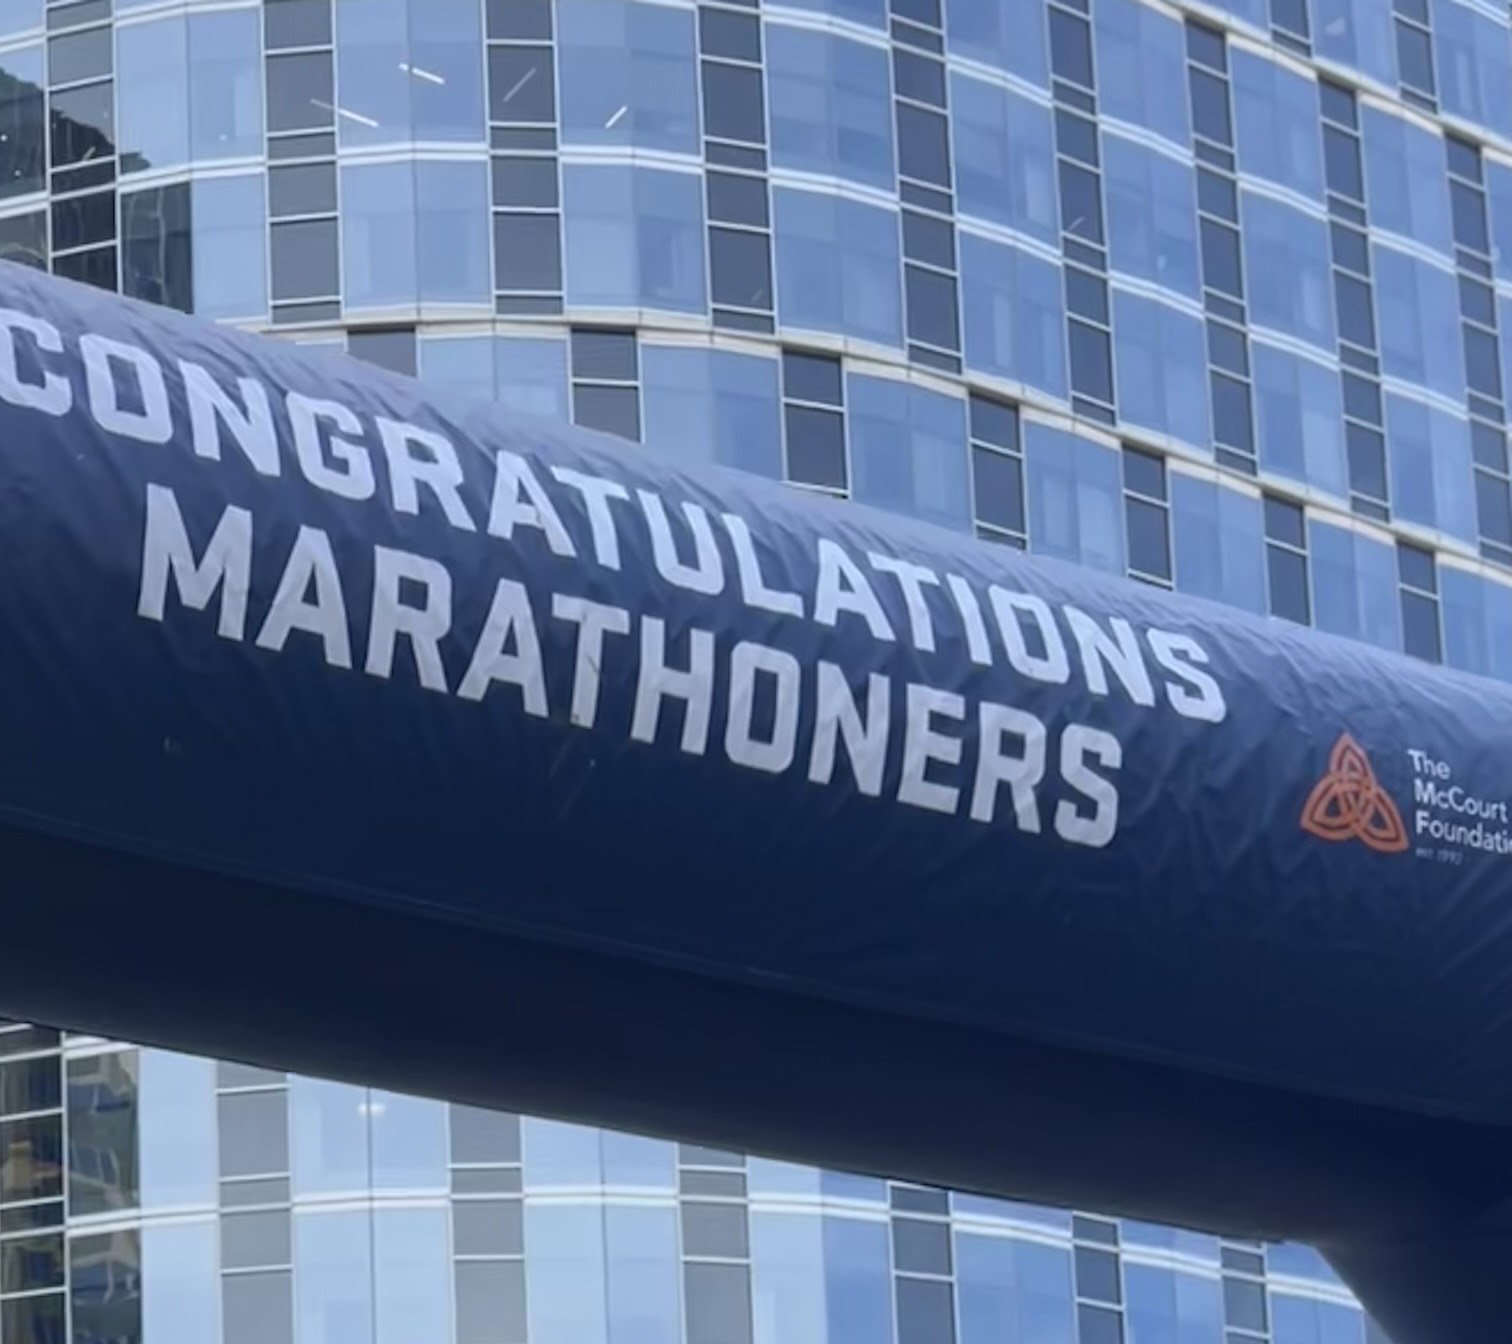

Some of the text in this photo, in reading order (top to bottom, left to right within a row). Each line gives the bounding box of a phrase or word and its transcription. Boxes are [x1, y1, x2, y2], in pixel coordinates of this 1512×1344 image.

[137, 482, 1124, 849] MARATHONERS
[1407, 748, 1451, 780] The
[1414, 777, 1509, 824] McCourt
[1416, 810, 1512, 855] Foundati
